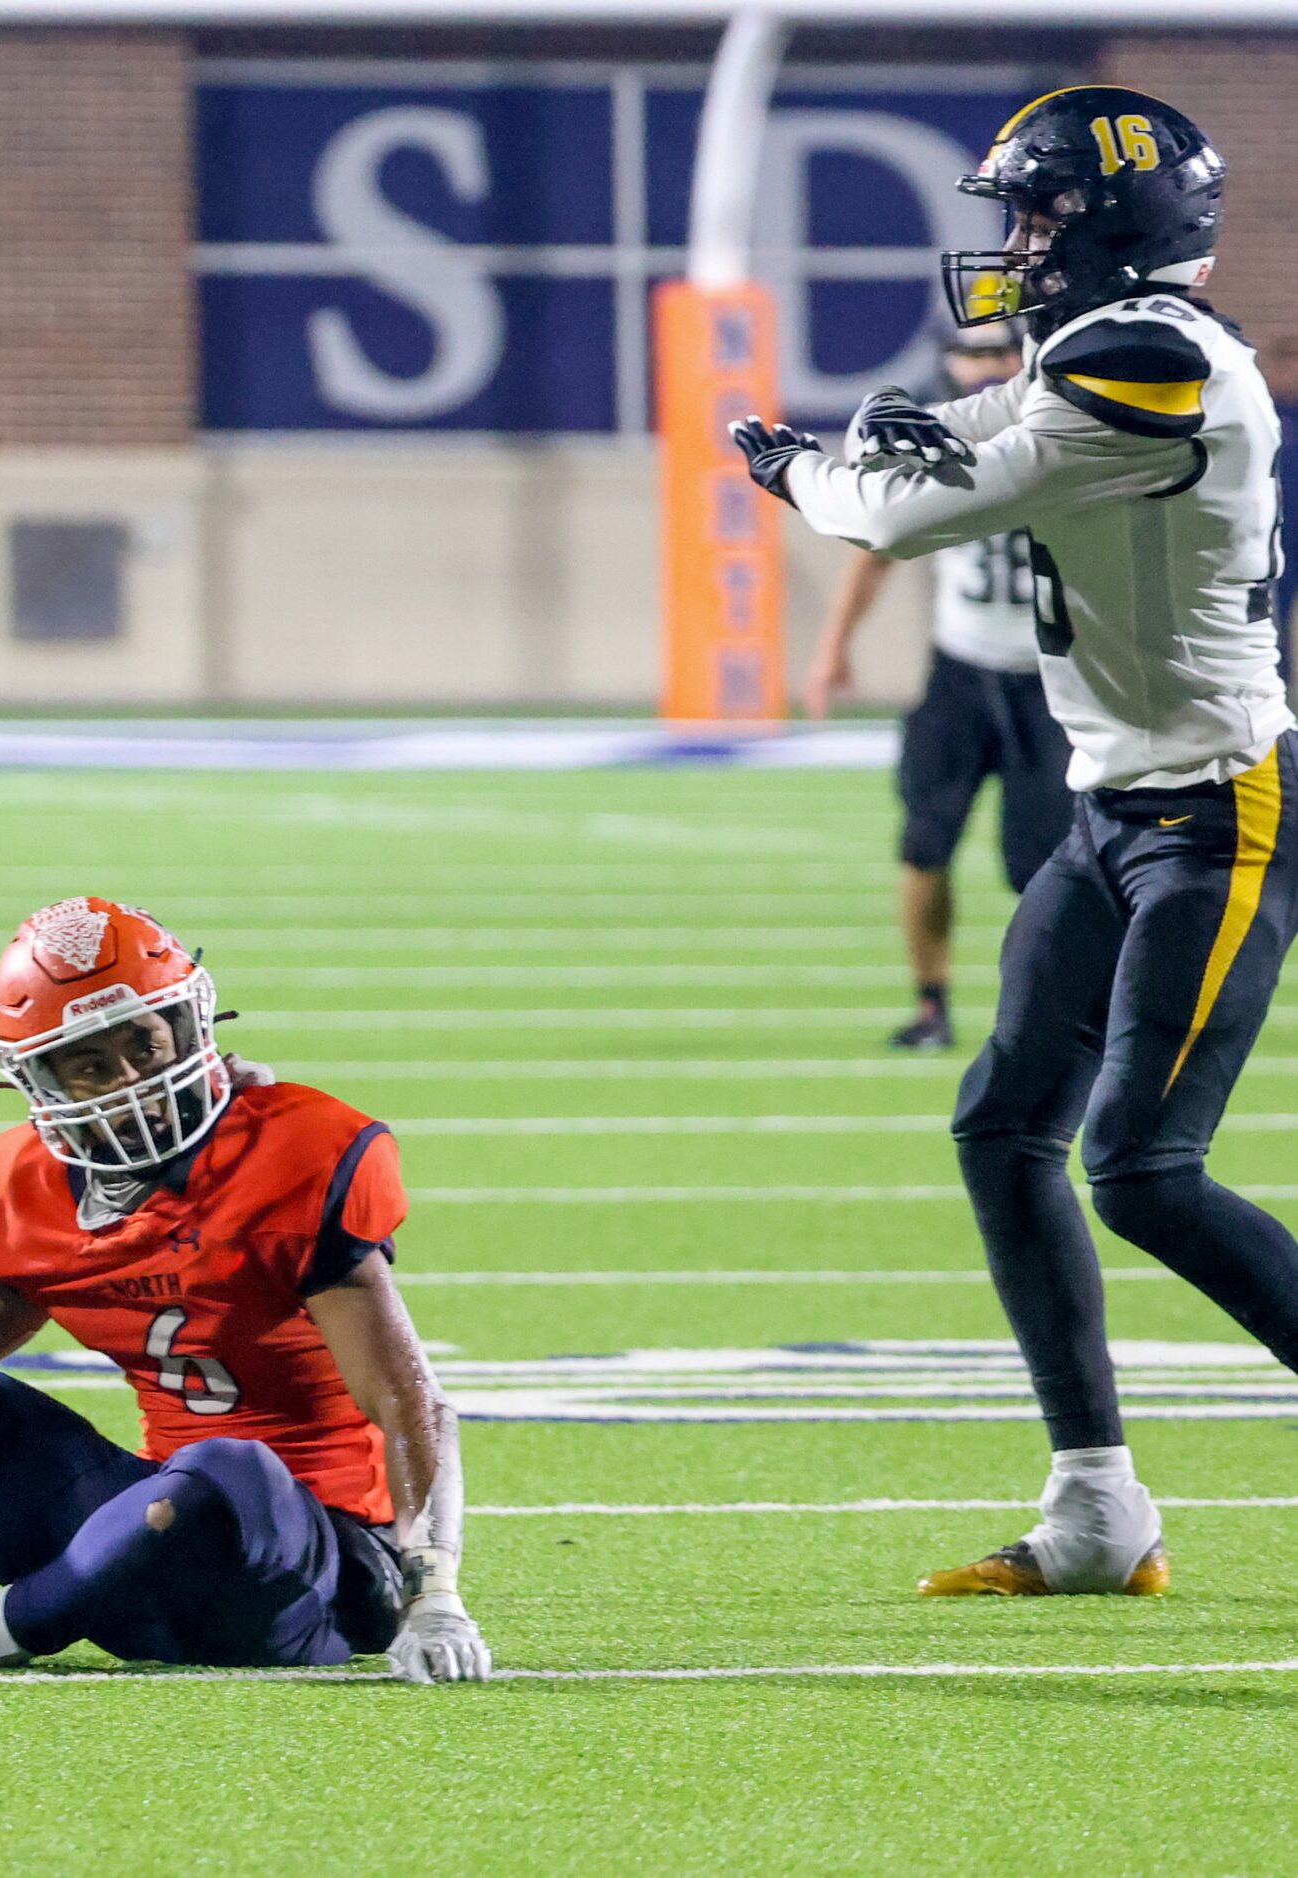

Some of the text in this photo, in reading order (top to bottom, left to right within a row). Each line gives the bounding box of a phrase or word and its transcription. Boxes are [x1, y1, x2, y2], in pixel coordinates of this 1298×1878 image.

[1090, 114, 1161, 175] 16
[70, 986, 126, 1017] Riddell
[107, 1272, 183, 1298] NORTH
[145, 1304, 241, 1416] 6
